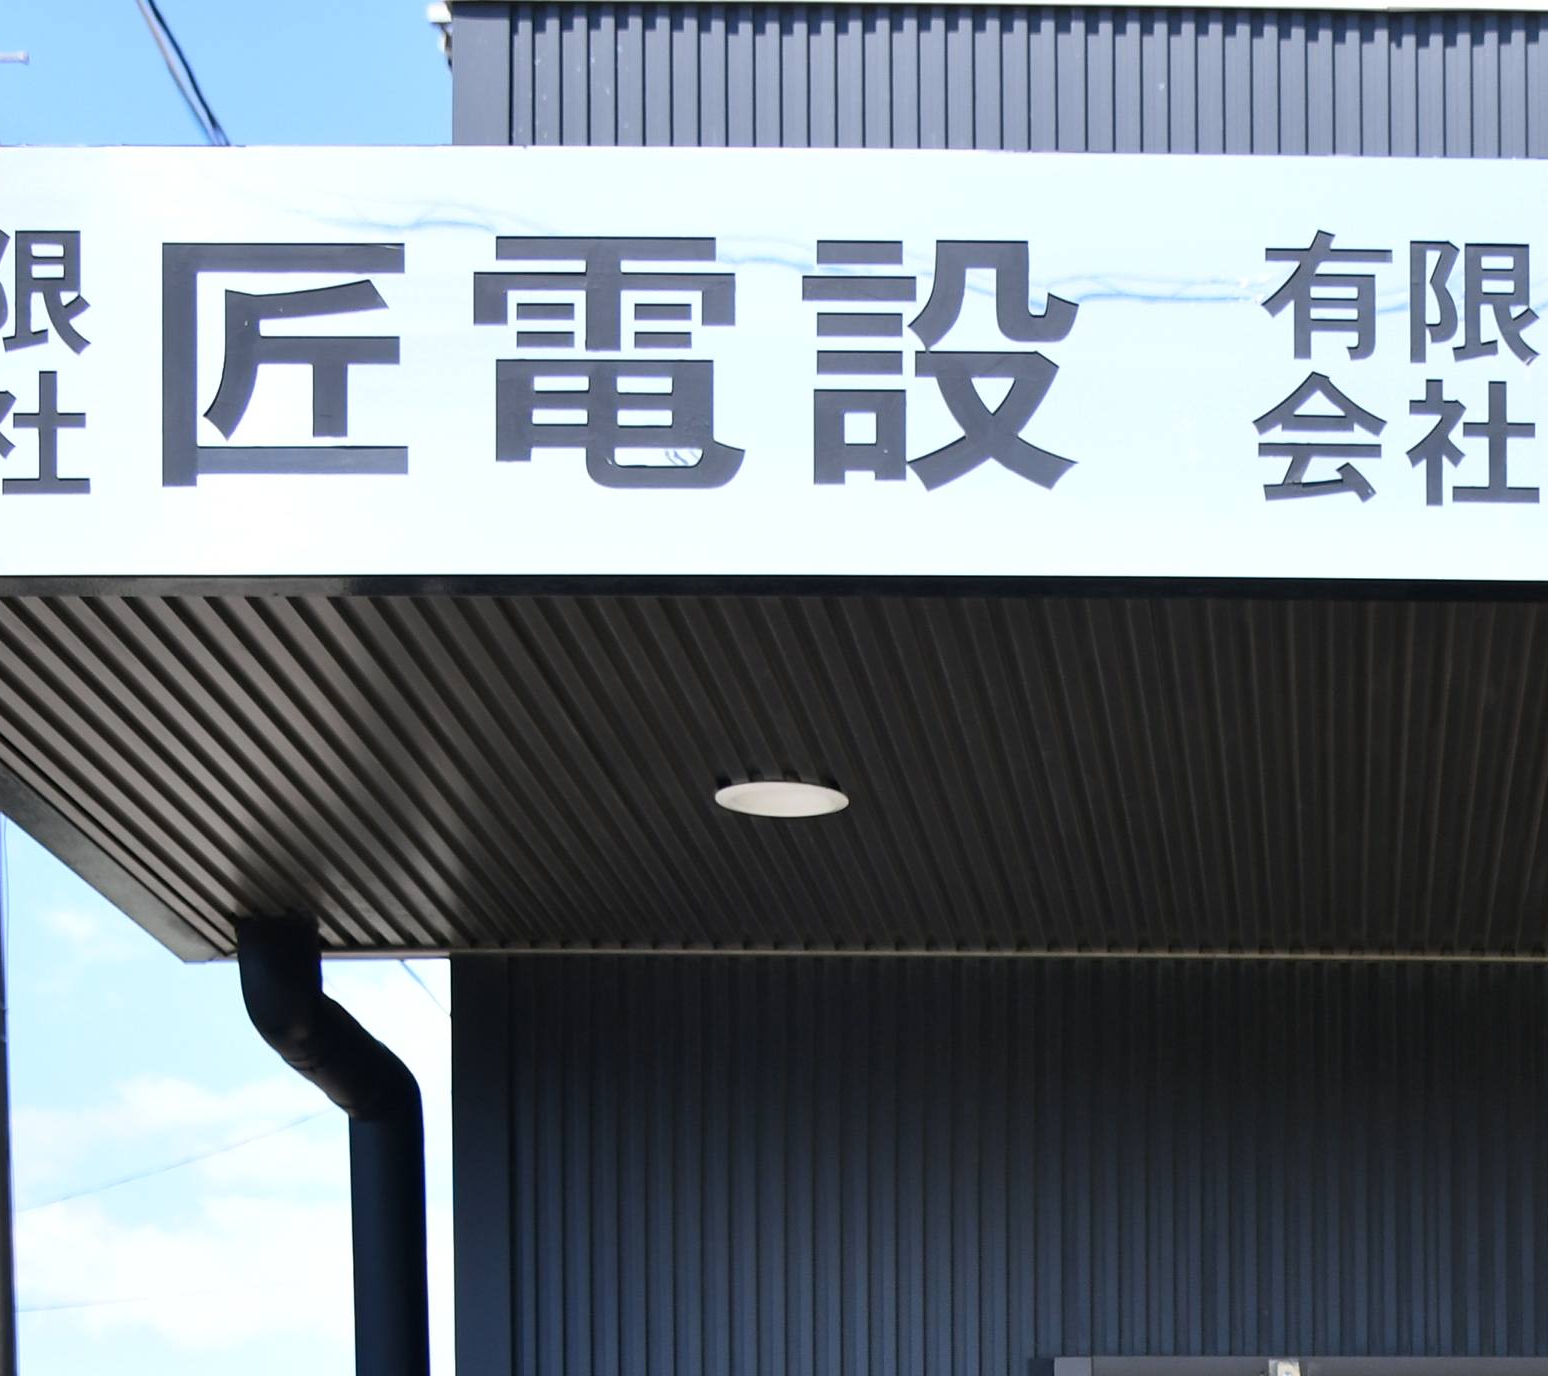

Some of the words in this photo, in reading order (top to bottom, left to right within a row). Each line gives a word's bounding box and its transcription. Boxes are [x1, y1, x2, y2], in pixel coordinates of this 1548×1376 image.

[161, 235, 1080, 490] 匠電設
[1259, 228, 1540, 364] 有限
[1252, 371, 1540, 506] 会社
